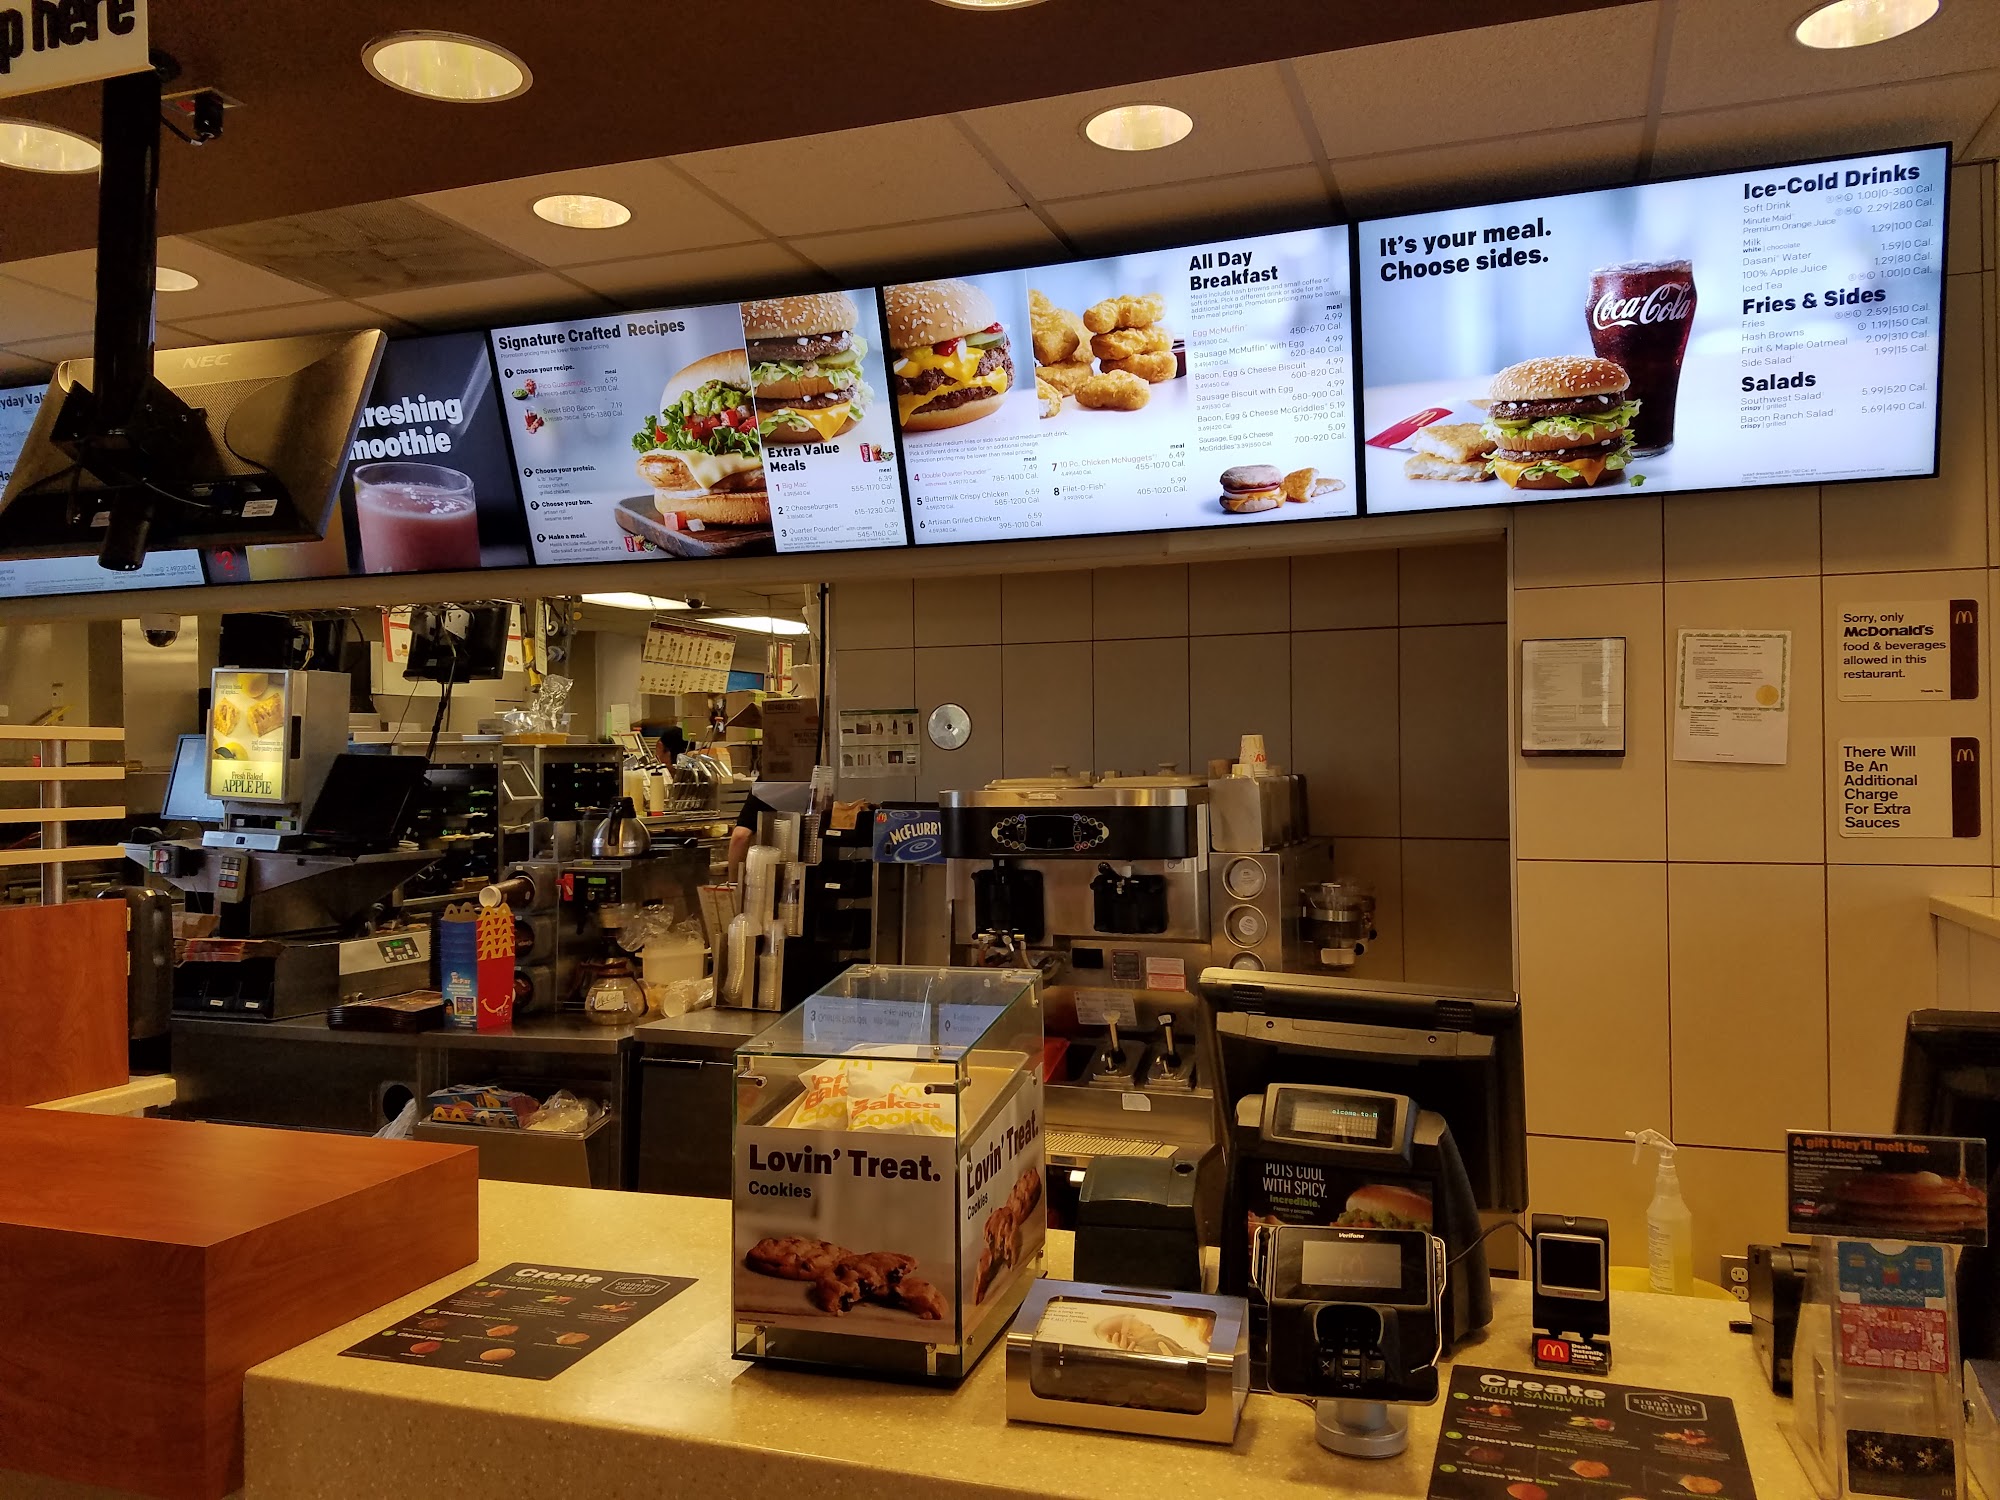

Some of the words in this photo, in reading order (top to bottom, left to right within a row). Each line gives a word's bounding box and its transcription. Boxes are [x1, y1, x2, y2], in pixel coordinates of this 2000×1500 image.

[32, 0, 135, 51] here
[1745, 172, 1838, 200] Ice-Cold
[1845, 165, 1920, 187] Drinks
[1744, 205, 1763, 213] Soft
[1766, 201, 1791, 210] Drink
[1743, 217, 1770, 225] Minute
[1743, 225, 1780, 234] Premium
[1782, 222, 1812, 230] Orange
[1814, 218, 1836, 226] Juice
[1380, 235, 1417, 257] It's
[1423, 230, 1477, 255] your
[1483, 217, 1552, 244] meal.
[1743, 238, 1761, 246] Milk
[1189, 253, 1213, 271] All
[1218, 252, 1252, 267] Day
[1782, 252, 1811, 261] Water
[1380, 259, 1470, 282] Choose
[1476, 248, 1549, 269] sides.
[1743, 270, 1768, 279] 100%
[1770, 267, 1798, 276] Apple
[1801, 264, 1827, 273] Juice
[1191, 266, 1278, 290] Breakfast
[1742, 284, 1762, 292] Iced
[1765, 282, 1782, 290] Tea
[1593, 282, 1693, 330] Coca-Cola
[1743, 296, 1796, 315] Fries
[1802, 292, 1818, 308] &
[1824, 288, 1886, 306] Sides
[1742, 320, 1765, 328] Fries
[498, 332, 566, 350] Signature
[568, 324, 621, 343] Crafted
[627, 320, 686, 336] Recipes
[1193, 329, 1207, 337] Egg
[1742, 332, 1766, 341] Hash
[1769, 329, 1804, 338] Browns
[1194, 350, 1227, 359] Sausage
[1270, 342, 1286, 350] with
[1289, 340, 1304, 348] Egg
[1742, 346, 1763, 354] Fruit
[1776, 342, 1804, 352] Maple
[1807, 338, 1848, 349] Oatmeal
[183, 354, 232, 368] NEC
[1765, 356, 1792, 364] Salad
[540, 366, 553, 374] your
[553, 364, 575, 372] recipe.
[1195, 372, 1219, 380] Bacon,
[1223, 370, 1238, 378] Egg
[1248, 366, 1276, 374] Cheese
[1278, 362, 1306, 371] Biscuit
[1742, 372, 1816, 392] Salads
[0, 396, 24, 410] yday
[1741, 395, 1792, 405] Southwest
[1794, 392, 1822, 401] Salad
[1741, 414, 1771, 423] Bacon
[1773, 411, 1804, 421] Ranch
[1806, 409, 1834, 418] Salad
[768, 446, 800, 458] Extra
[803, 444, 840, 456] Value
[770, 460, 806, 472] Meals
[1052, 463, 1057, 471] 7
[1054, 488, 1060, 496] 8
[781, 529, 787, 537] 3
[1844, 614, 1877, 623] Sorry,
[1880, 612, 1904, 623] only
[1844, 625, 1934, 637] McDonald's
[1844, 642, 1869, 650] food
[1873, 642, 1881, 650] &
[1885, 642, 1946, 651] beverages
[1844, 655, 1888, 664] allowed
[1892, 655, 1902, 663] in
[1905, 655, 1926, 663] this
[1844, 669, 1905, 678] restaurant.
[1844, 746, 1886, 757] There
[1890, 746, 1916, 756] Will
[1845, 761, 1864, 772] Be
[1869, 761, 1888, 772] An
[247, 772, 263, 780] Baked
[1844, 775, 1918, 786] Additional
[222, 780, 253, 793] APPLE
[255, 781, 272, 794] PIE
[1844, 788, 1898, 801] Charge
[1845, 803, 1869, 814] For
[1874, 803, 1911, 814] Extra
[1845, 817, 1900, 828] Sauces
[1793, 1137, 1803, 1147] A
[1806, 1138, 1830, 1149] gift
[1832, 1137, 1872, 1152] they'll
[1875, 1142, 1904, 1152] melt
[1907, 1143, 1929, 1153] for.
[967, 1134, 1004, 1199] Lovin'
[1007, 1109, 1038, 1161] Treat.
[750, 1144, 840, 1174] Lovin'
[848, 1150, 942, 1182] Treat.
[1266, 1163, 1293, 1177] PUTS
[749, 1181, 812, 1198] Cookies
[1263, 1177, 1291, 1193] WITH
[1295, 1181, 1328, 1198] SPICY.
[968, 1193, 988, 1220] Cookies
[1270, 1195, 1320, 1208] Incredible.
[504, 1276, 533, 1286] YOUR
[534, 1278, 592, 1290] SANDWICH
[514, 1268, 602, 1284] Create
[1480, 1374, 1606, 1400] Create
[1480, 1384, 1520, 1397] YOUR
[1524, 1390, 1605, 1408] SANDWICH
[1474, 1396, 1512, 1406] Choose
[1514, 1400, 1537, 1408] your
[1538, 1403, 1572, 1412] recipe
[1633, 1398, 1698, 1411] SIGNATURE
[1640, 1404, 1692, 1416] CRAFTED
[1468, 1434, 1508, 1446] Choose
[1510, 1441, 1535, 1450] your
[1537, 1445, 1578, 1455] protein
